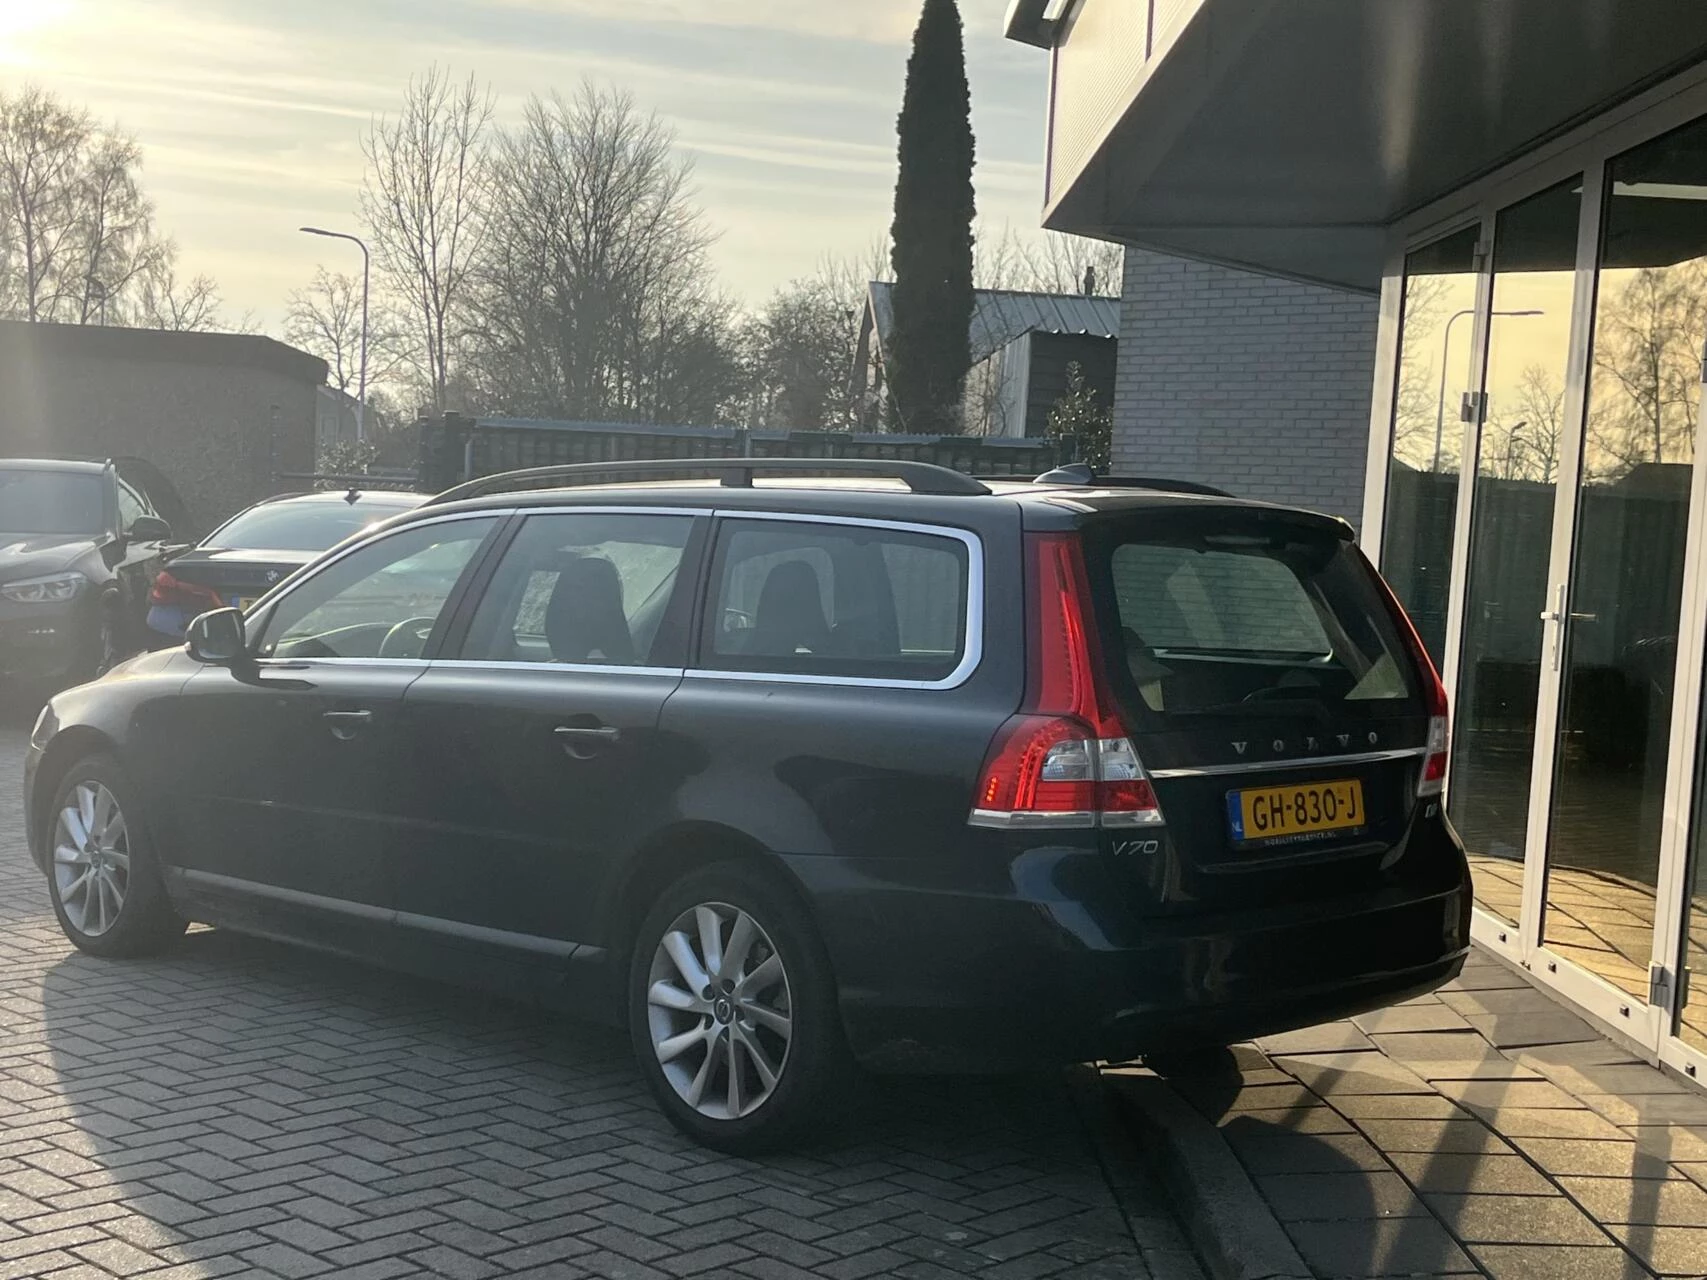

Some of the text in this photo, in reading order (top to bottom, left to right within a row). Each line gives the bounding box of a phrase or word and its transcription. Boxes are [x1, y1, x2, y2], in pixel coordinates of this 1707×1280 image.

[1231, 731, 1379, 754] VOLVO
[1252, 785, 1357, 831] GH-830-J
[1111, 839, 1159, 856] V70
